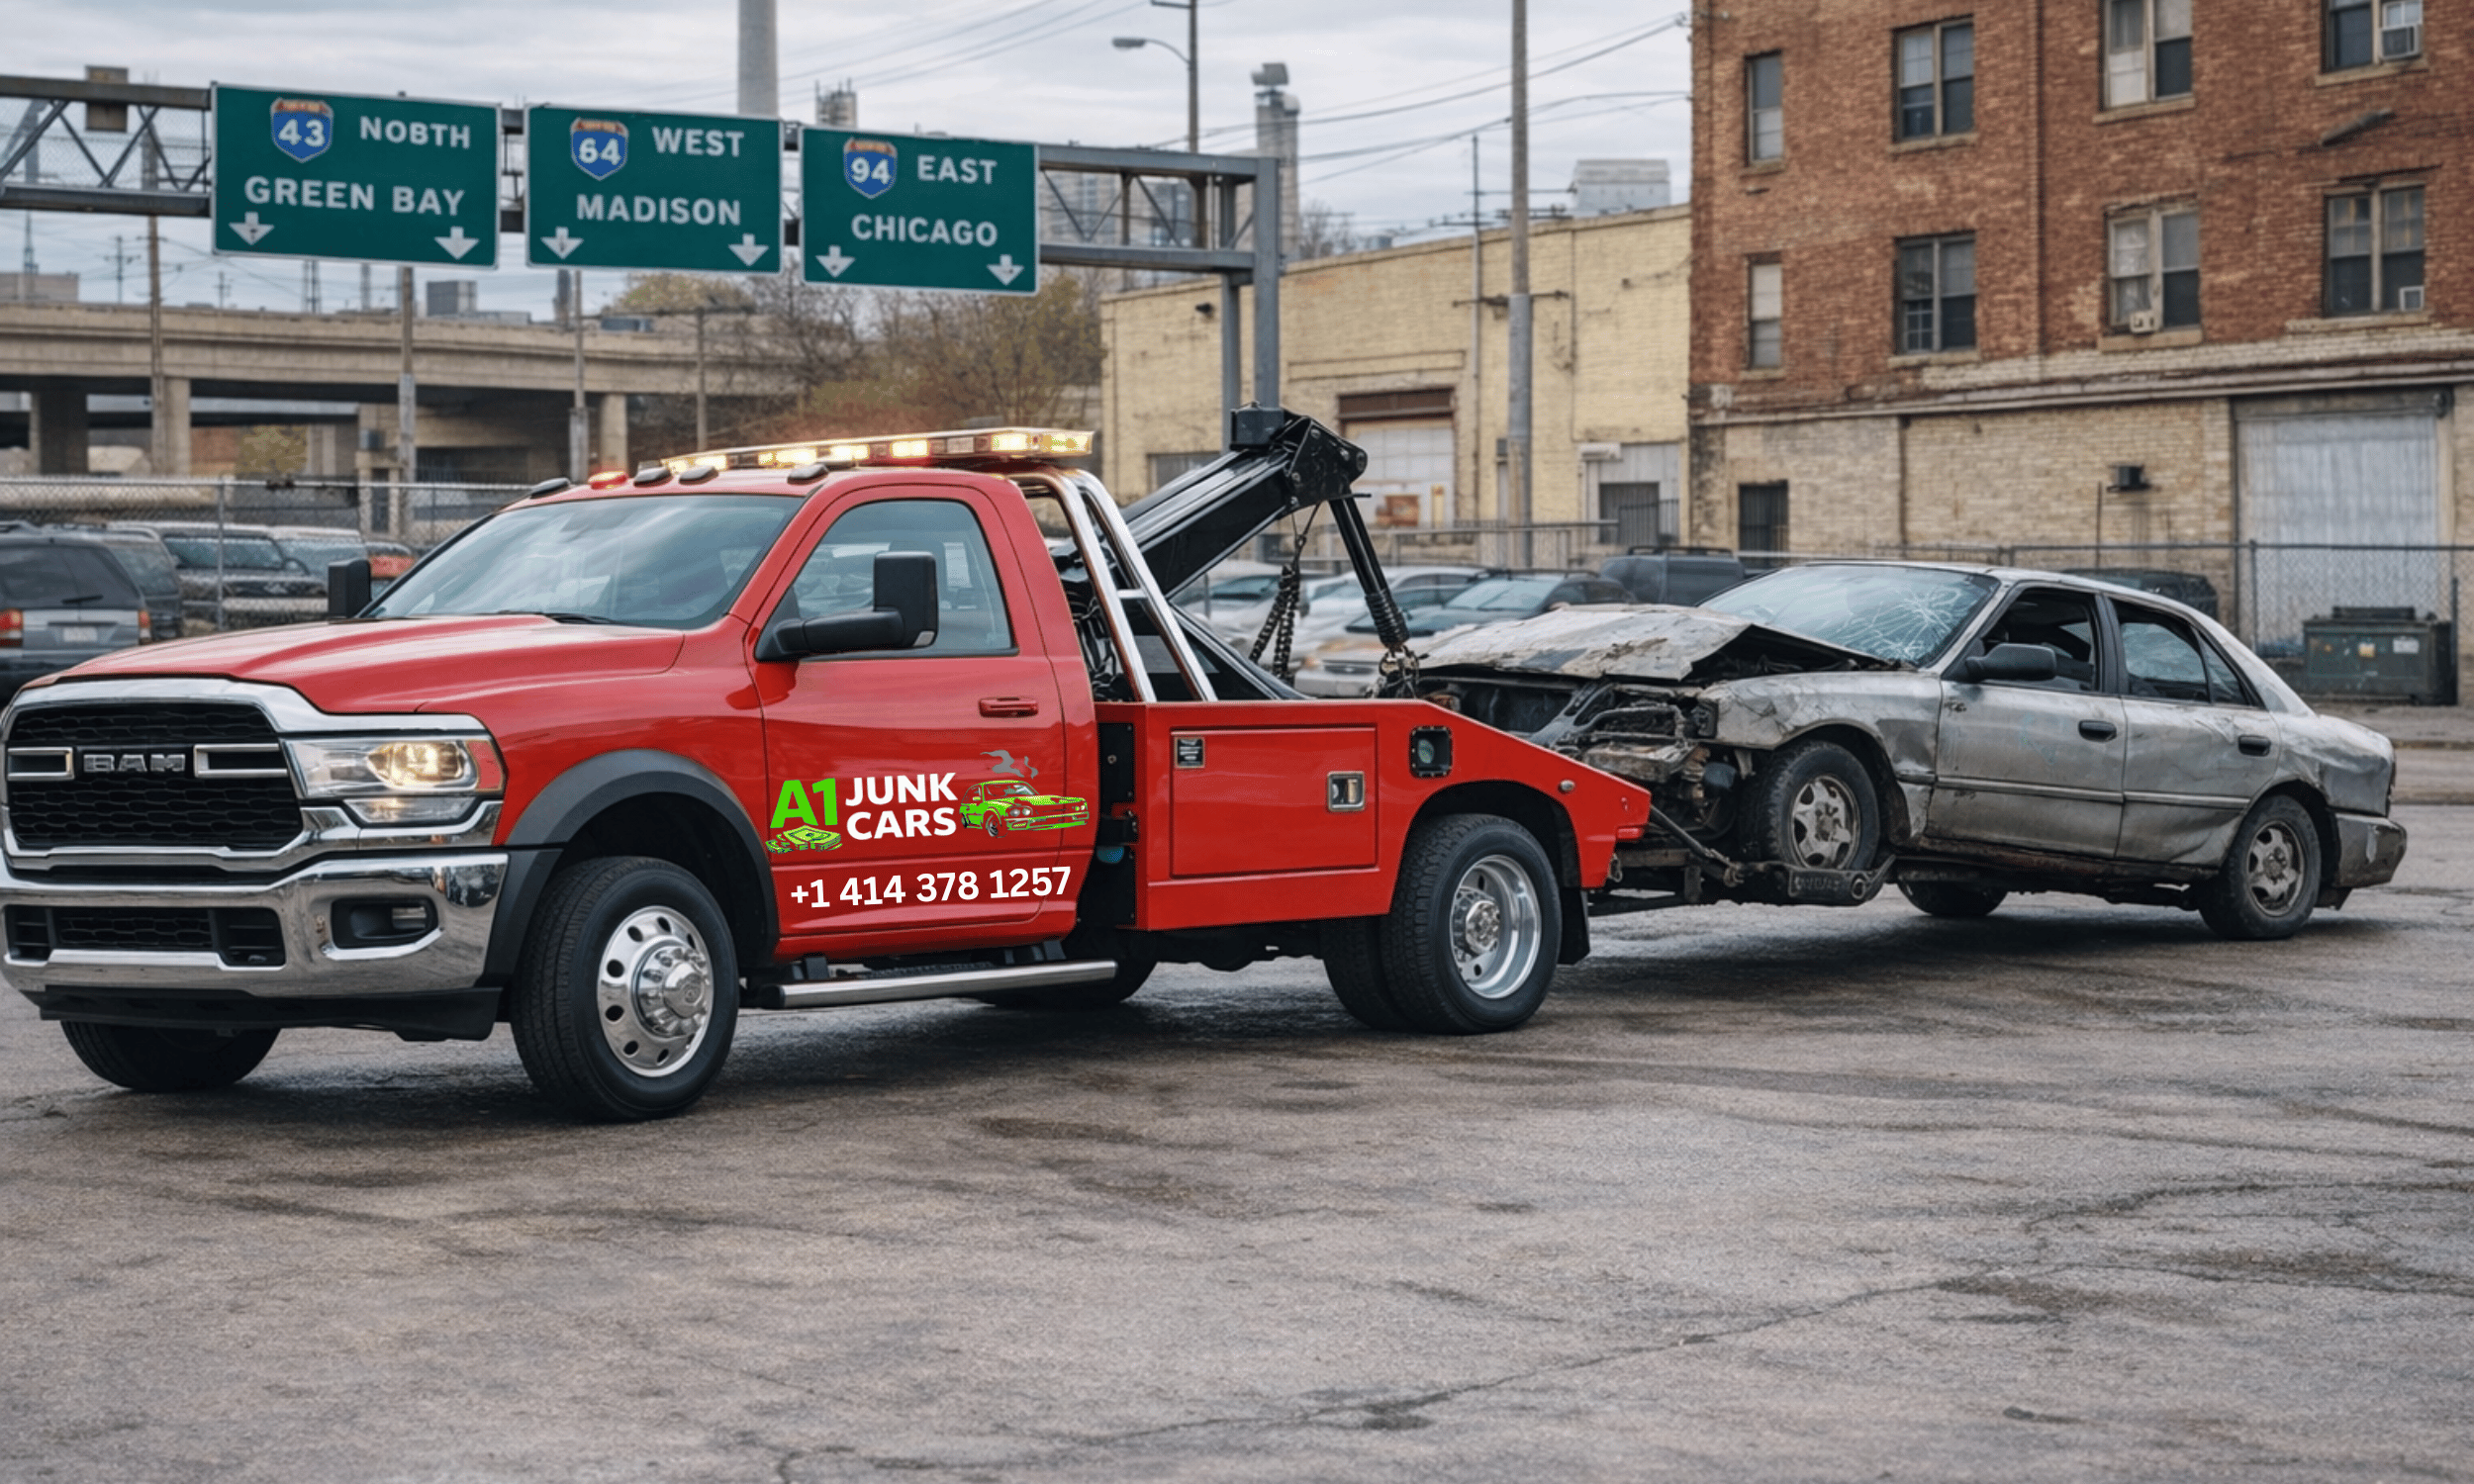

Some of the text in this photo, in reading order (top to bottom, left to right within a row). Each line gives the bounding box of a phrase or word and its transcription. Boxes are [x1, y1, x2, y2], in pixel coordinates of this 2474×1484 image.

[278, 119, 326, 147] 43
[579, 127, 744, 165] 64 WEST
[851, 155, 997, 185] 94 EAST
[244, 176, 464, 216] GREEN BAY
[577, 194, 740, 226] MADISON
[851, 214, 998, 247] CHICAGO
[770, 778, 838, 829] A1
[845, 772, 958, 806] JUNK
[845, 806, 957, 840] CARS
[791, 866, 1071, 908] +1 414 378 1257
